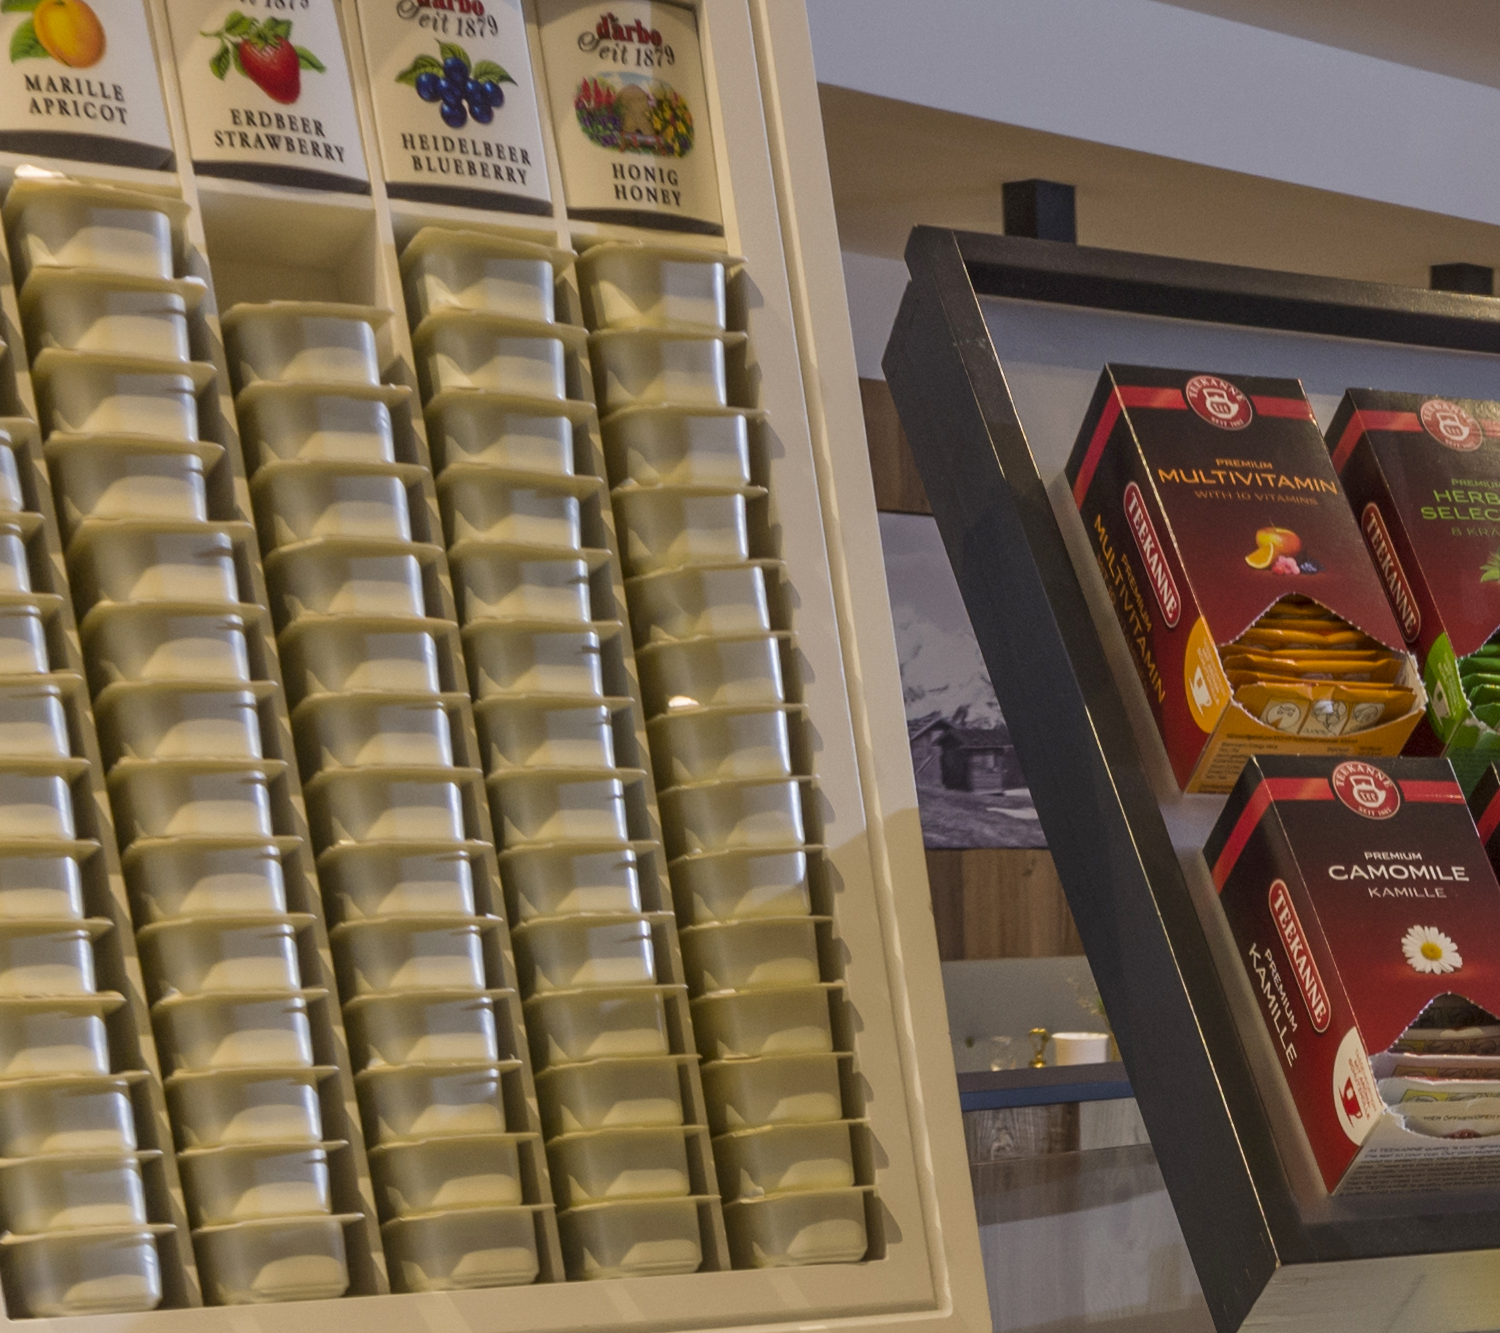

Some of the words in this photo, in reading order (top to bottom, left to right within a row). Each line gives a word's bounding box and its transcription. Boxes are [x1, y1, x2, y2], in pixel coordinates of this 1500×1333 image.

[456, 16, 499, 37] 1879
[634, 45, 676, 68] 1879
[25, 74, 125, 102] MARILLE
[28, 97, 128, 125] APRICOT
[231, 109, 325, 137] ERDBEER
[215, 131, 346, 164] STRAWBERRY
[401, 133, 533, 168] HEIDELBEER
[411, 155, 528, 186] BLUEBERRY
[612, 162, 679, 187] HONIG
[613, 182, 682, 207] HONEY
[1189, 375, 1245, 402] TEEKANNE
[1215, 458, 1274, 470] PREMIUM
[1157, 468, 1338, 495] MULTIVITAMIN
[1195, 490, 1232, 499] WITH
[1254, 493, 1319, 506] VITAMINS
[1128, 491, 1177, 618] TEEKANNE
[1366, 512, 1417, 635] TEEKANNE
[1121, 553, 1151, 632] PREMIUM
[1094, 514, 1166, 704] MULTIVITAMIN
[1336, 763, 1393, 788] TEEKANNE
[1364, 851, 1422, 861] PREMIUM
[1329, 865, 1469, 881] CAMOMILE
[1368, 887, 1447, 898] KAMILLE
[1274, 889, 1327, 1024] TEEKANNE
[1264, 948, 1297, 1032] PREMIUM
[1249, 942, 1297, 1068] KAMILLE
